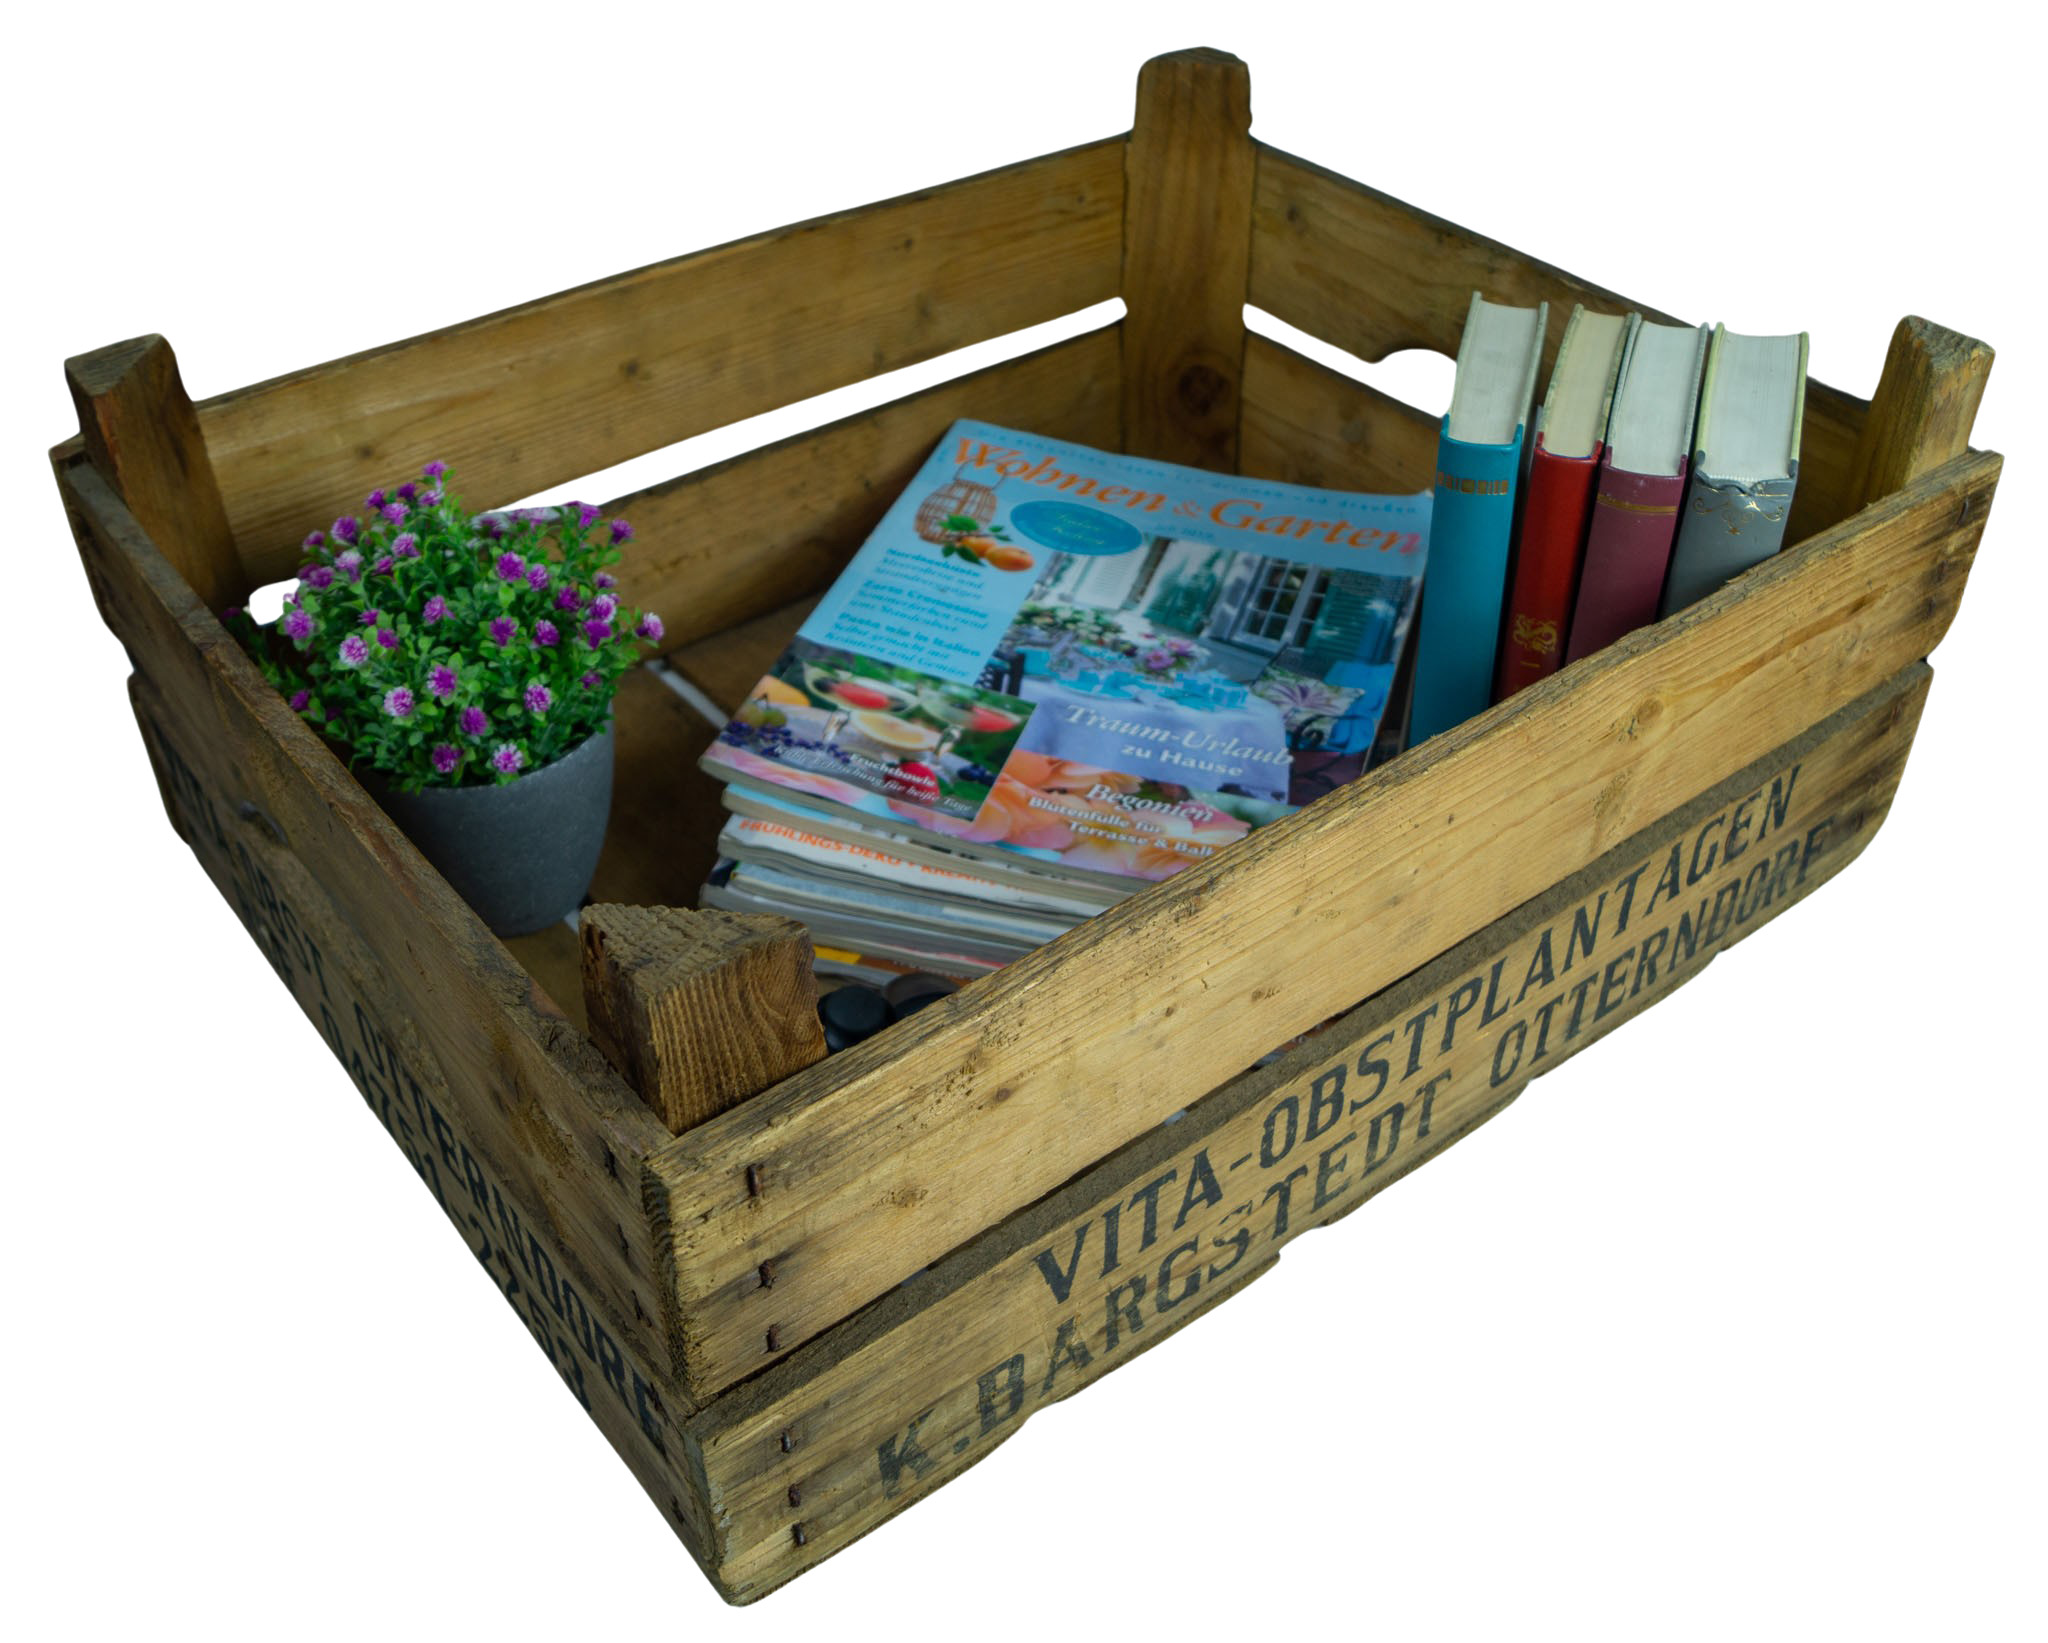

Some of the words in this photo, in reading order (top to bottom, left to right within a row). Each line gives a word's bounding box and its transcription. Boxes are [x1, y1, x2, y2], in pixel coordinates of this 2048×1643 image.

[956, 437, 1167, 511] Wohnen
[1173, 500, 1203, 517] &
[1210, 498, 1421, 554] Garten
[1066, 704, 1294, 766] Traum-Urlaub
[850, 753, 936, 787] Fruchtbowle
[1121, 745, 1152, 760] zu
[1160, 749, 1243, 777] Hause
[943, 797, 974, 812] Tage
[1086, 784, 1214, 824] Begonien
[1069, 821, 1148, 846] Terrasse
[1154, 839, 1169, 850] &
[1033, 764, 1801, 1303] VITA-OBSTPLANTAGEN
[877, 1067, 1452, 1501] K.BARGSTEDT
[1489, 815, 1835, 1088] OTTERNDORF
